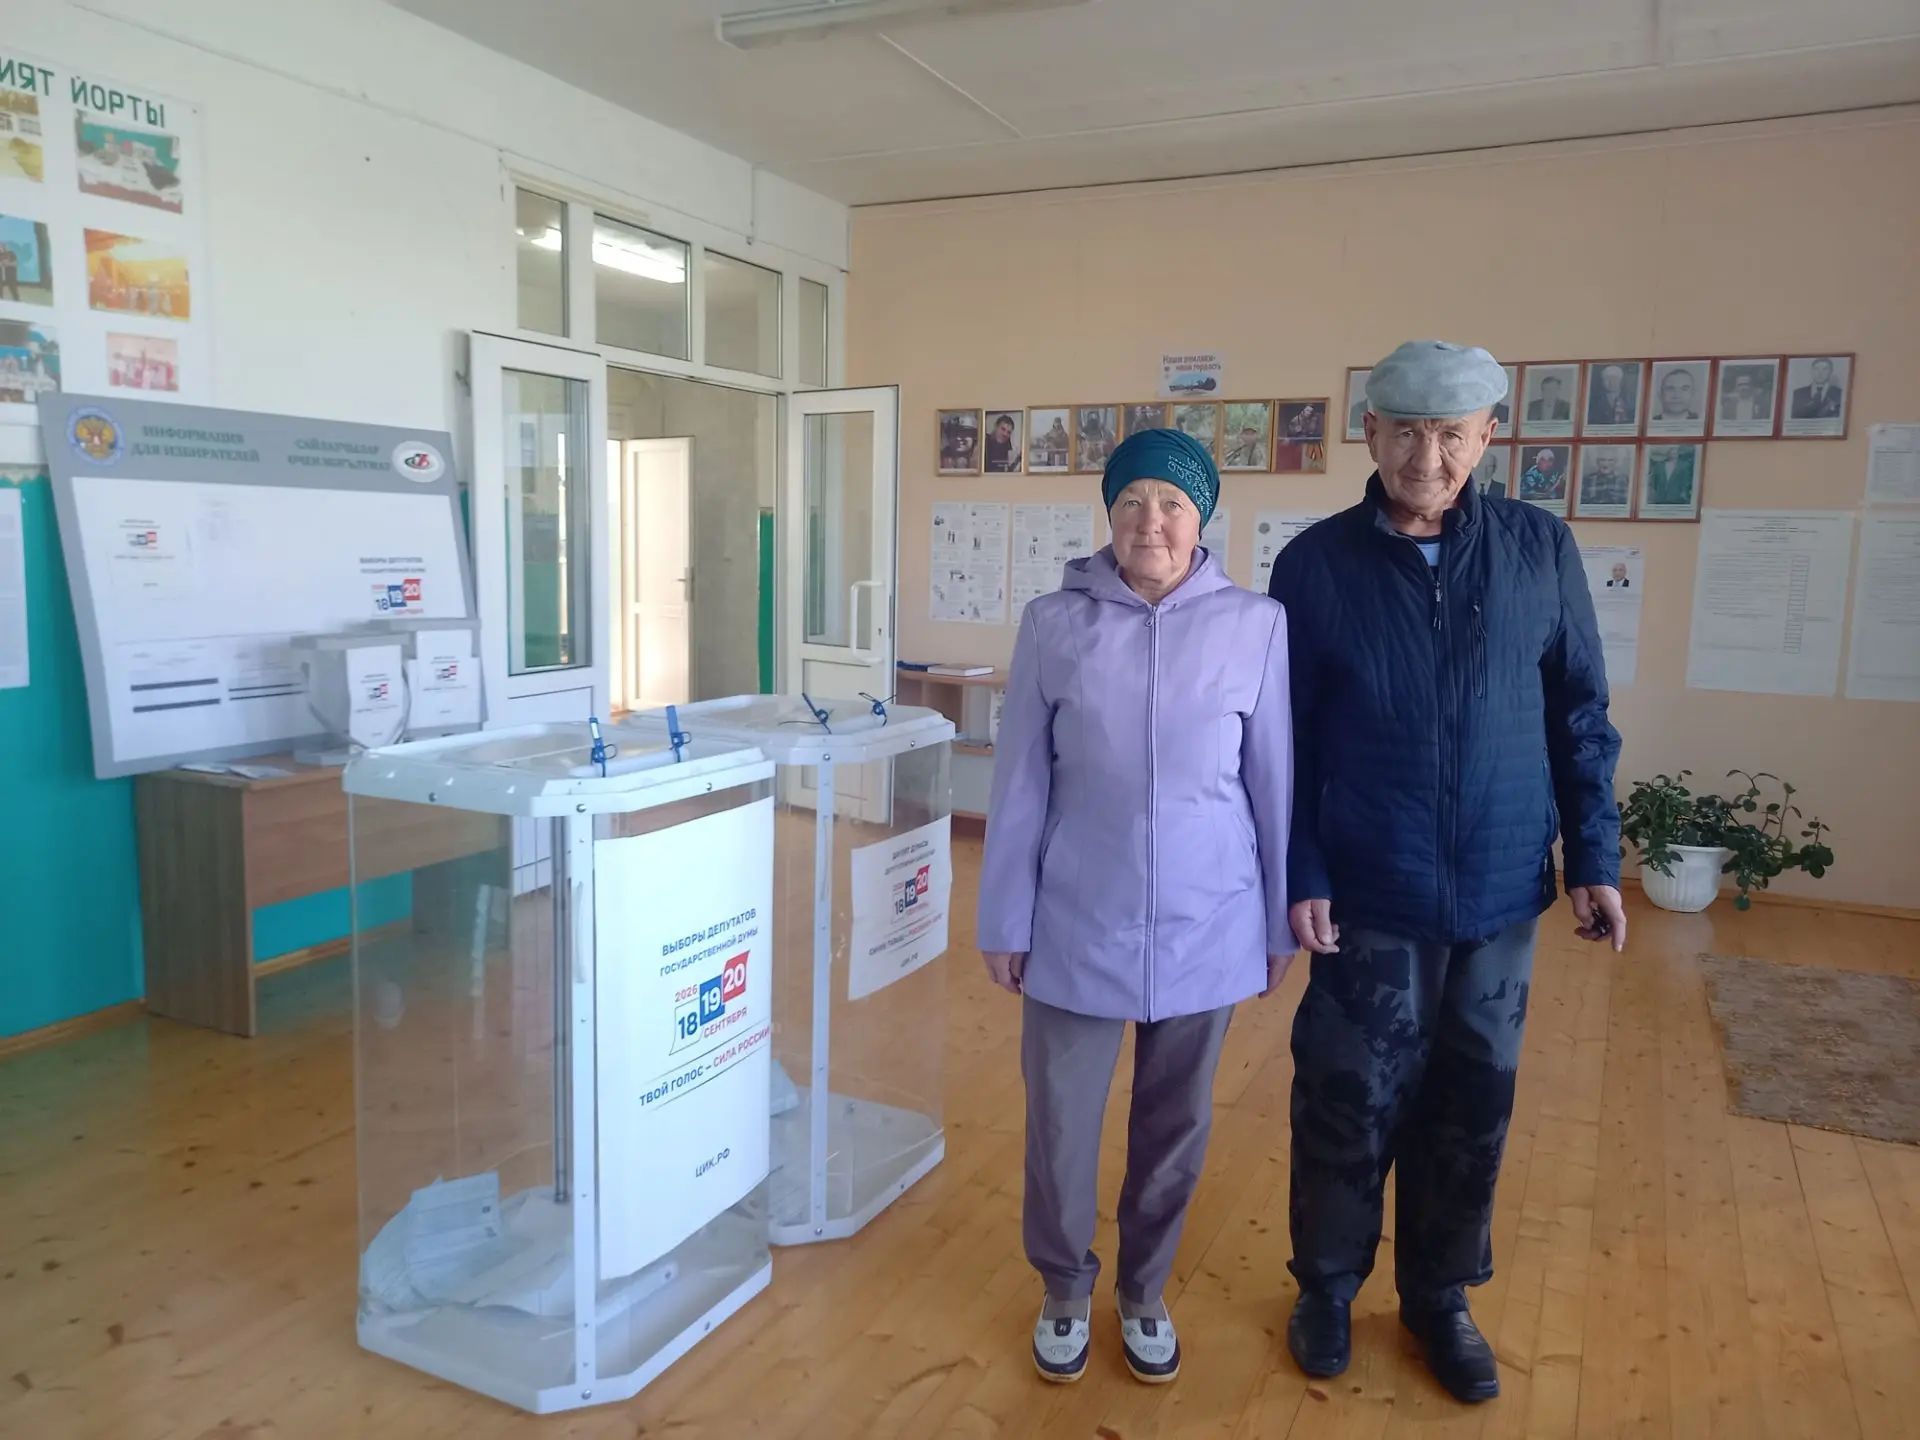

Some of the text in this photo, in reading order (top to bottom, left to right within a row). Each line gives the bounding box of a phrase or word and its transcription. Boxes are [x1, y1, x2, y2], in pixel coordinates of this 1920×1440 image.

[70, 75, 165, 128] ЙОРТЫ
[142, 425, 245, 445] ИНФОРМАЦИЯ
[163, 445, 260, 463] ИЗБИРАТЕЛЕЙ
[375, 598, 389, 610] 18
[403, 583, 419, 596] 20
[894, 899, 904, 915] 18
[905, 885, 916, 901] 19
[916, 872, 928, 890] 20
[660, 927, 759, 977] ГОСУДАРСТВЕННОЙ ДУМЫ
[662, 908, 757, 956] ВЫБОРЫ ДЕПУТАТОВ
[678, 963, 746, 1040] 18 19 20
[703, 1006, 748, 1038] СЕНТЯБРЯ
[639, 1081, 668, 1107] ТВОЙ
[671, 1065, 703, 1091] ГОЛОС
[713, 1047, 737, 1068] СИЛА
[737, 1026, 770, 1054] РОССИИ
[695, 1147, 731, 1178] ЦИК.РФ
